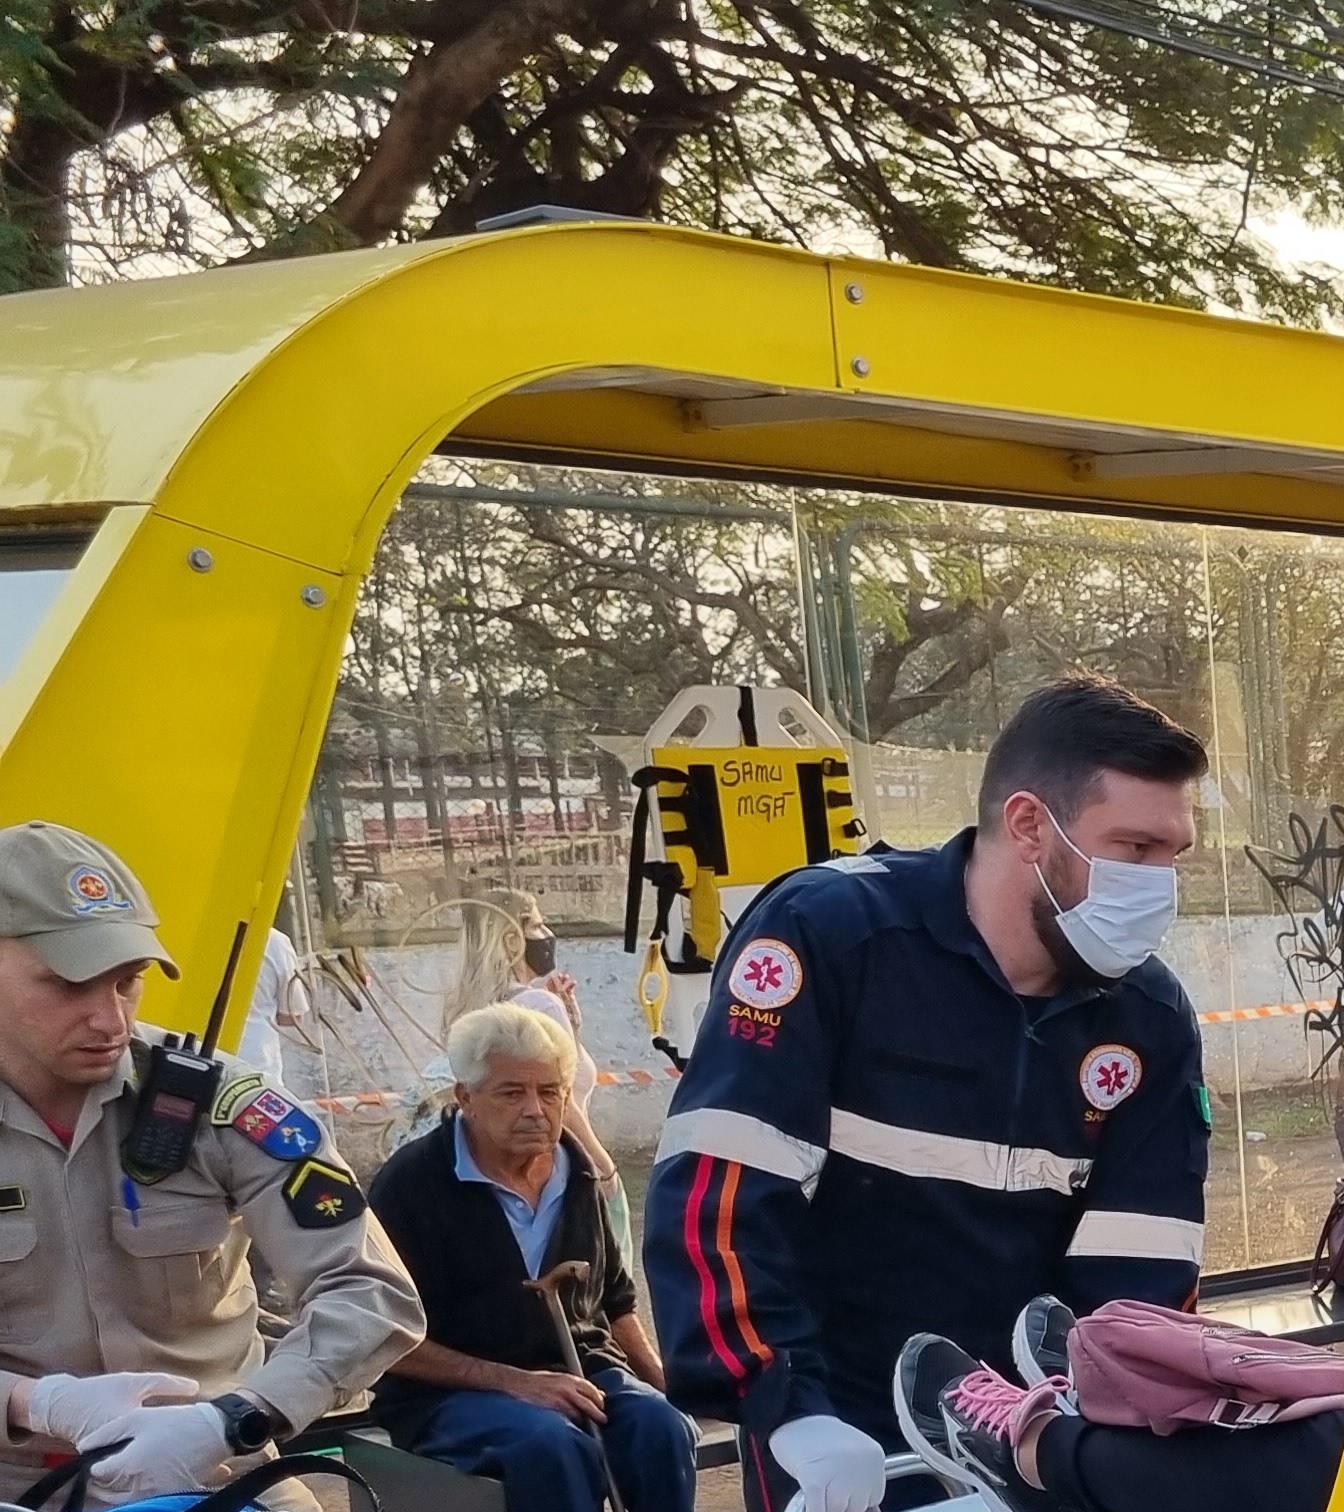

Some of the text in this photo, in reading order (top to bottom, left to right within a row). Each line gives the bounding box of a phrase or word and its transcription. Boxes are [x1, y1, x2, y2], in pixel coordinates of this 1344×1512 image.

[720, 760, 782, 787] SAMU
[729, 1004, 781, 1027] SAMU
[728, 1017, 776, 1047] 192
